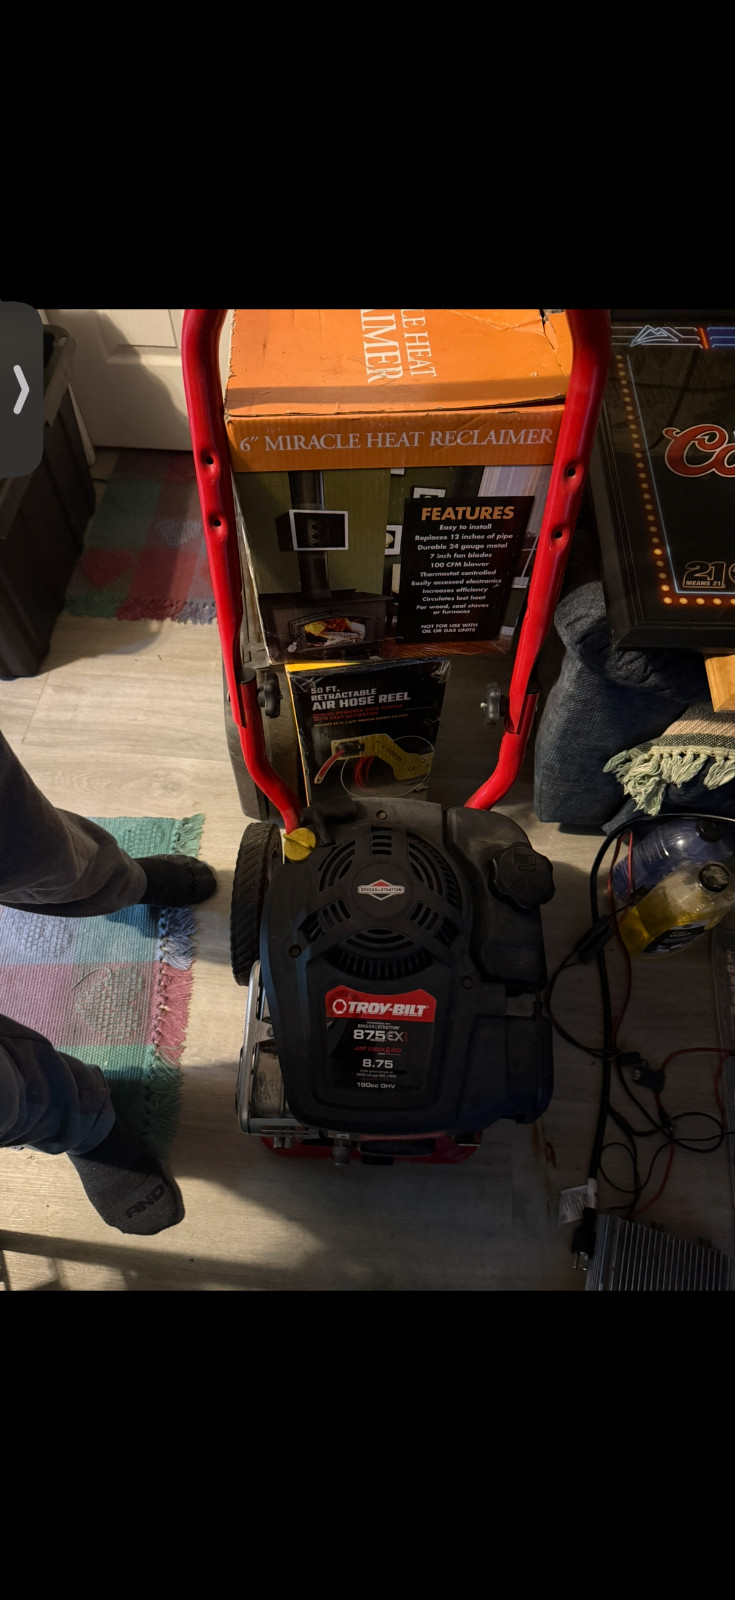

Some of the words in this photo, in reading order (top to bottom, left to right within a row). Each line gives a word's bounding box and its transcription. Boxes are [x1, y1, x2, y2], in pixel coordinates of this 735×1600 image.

[360, 309, 404, 383] IMER
[404, 331, 437, 377] HEAT
[264, 433, 361, 451] MIRACLE
[367, 431, 424, 448] HEAT
[430, 428, 554, 447] RECLAIMER
[421, 506, 515, 521] FEATURES
[685, 561, 726, 583] 21
[311, 688, 376, 701] RETRACTABLE
[312, 700, 336, 711] AIR
[340, 696, 375, 708] HOSE
[379, 692, 411, 703] REEL
[348, 1001, 427, 1017] TROY-BILT
[363, 1059, 393, 1068] 8.75
